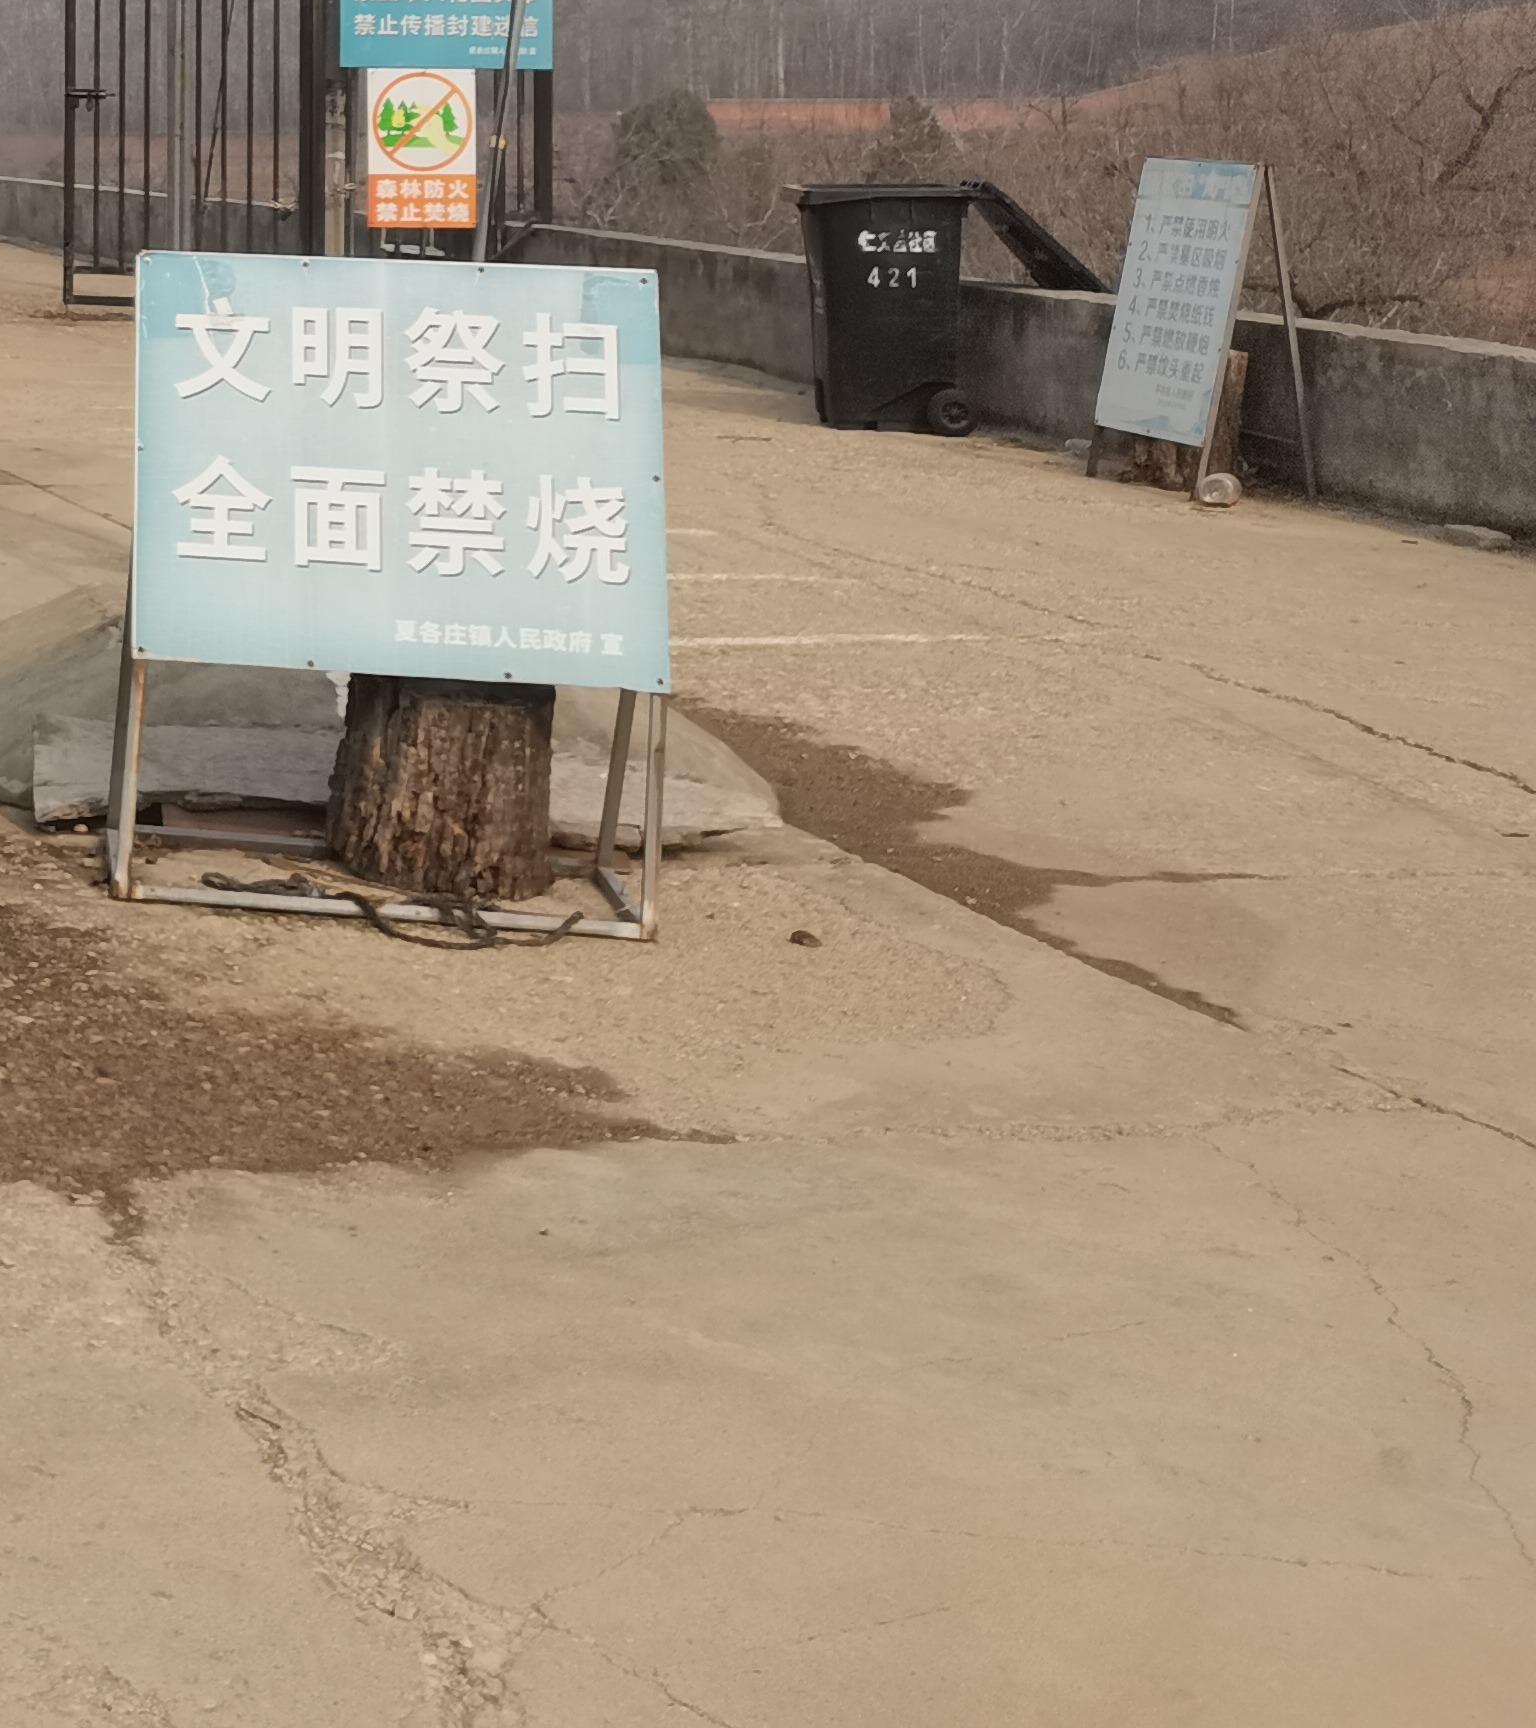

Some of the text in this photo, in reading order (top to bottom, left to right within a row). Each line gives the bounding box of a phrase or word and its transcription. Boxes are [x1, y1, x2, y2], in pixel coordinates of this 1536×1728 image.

[354, 14, 539, 37] 禁止传播封建迷信
[375, 179, 470, 199] 森林防火
[375, 202, 470, 222] 禁止焚烧
[867, 266, 917, 288] 421
[173, 296, 621, 421] 文明祭扫
[172, 454, 631, 585] 全面禁烧
[394, 619, 625, 656] 夏各庄镇人民政府 宣
